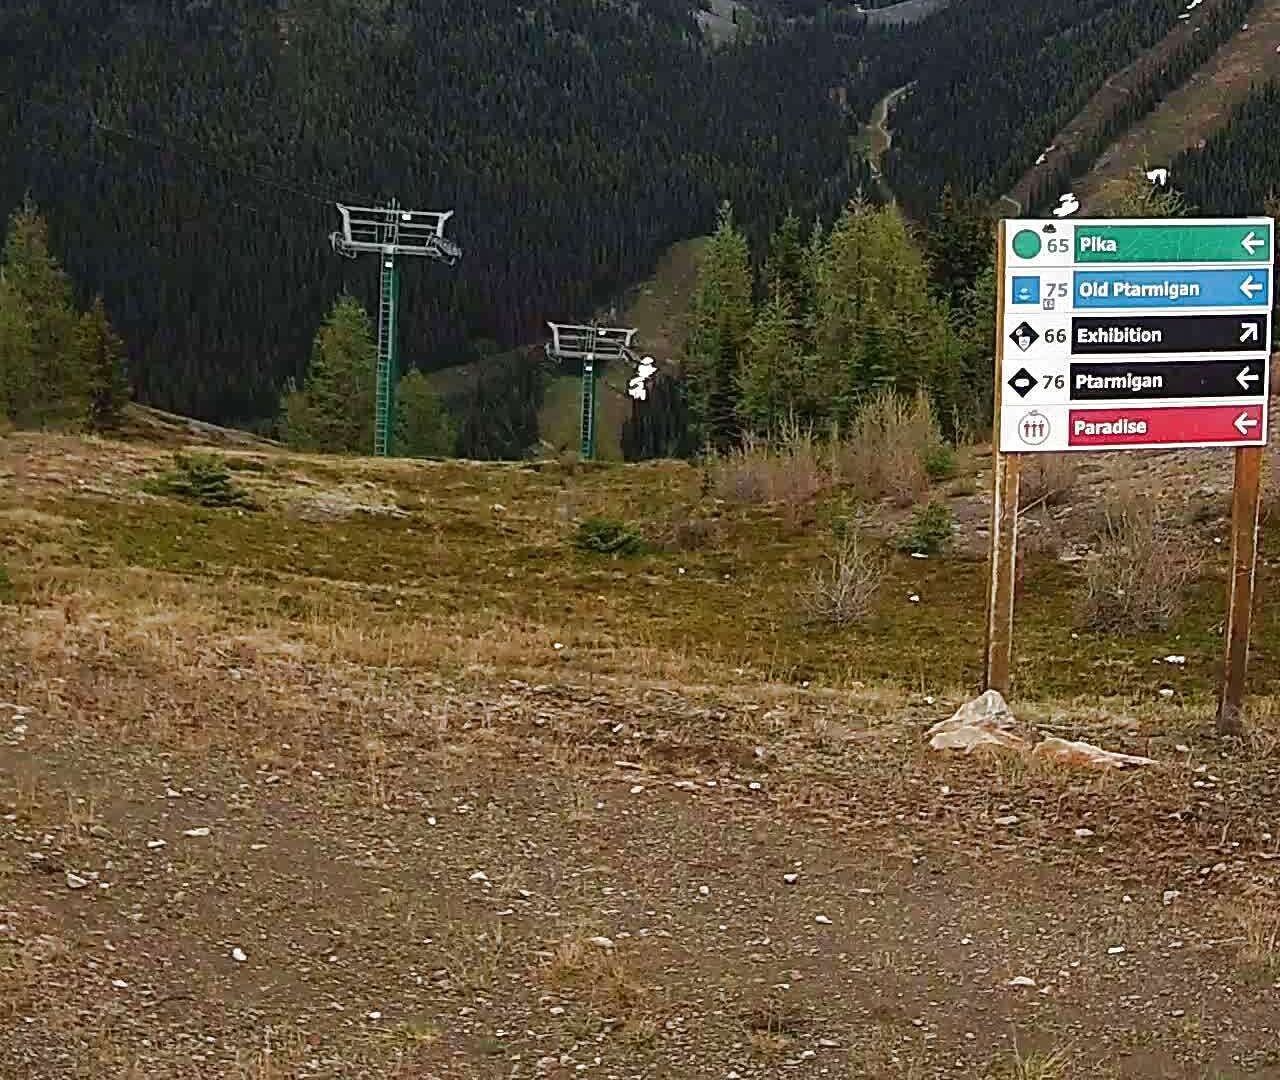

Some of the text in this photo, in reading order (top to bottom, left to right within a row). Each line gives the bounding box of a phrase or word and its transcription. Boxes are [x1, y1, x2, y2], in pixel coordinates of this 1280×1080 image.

[1047, 237, 1117, 252] 65 Pika
[1046, 282, 1200, 298] 75 Old Ptarmigan
[1044, 328, 1162, 343] 66 Exhibition
[1042, 374, 1162, 391] 76 Ptarmigan
[1074, 419, 1147, 435] Paradise
